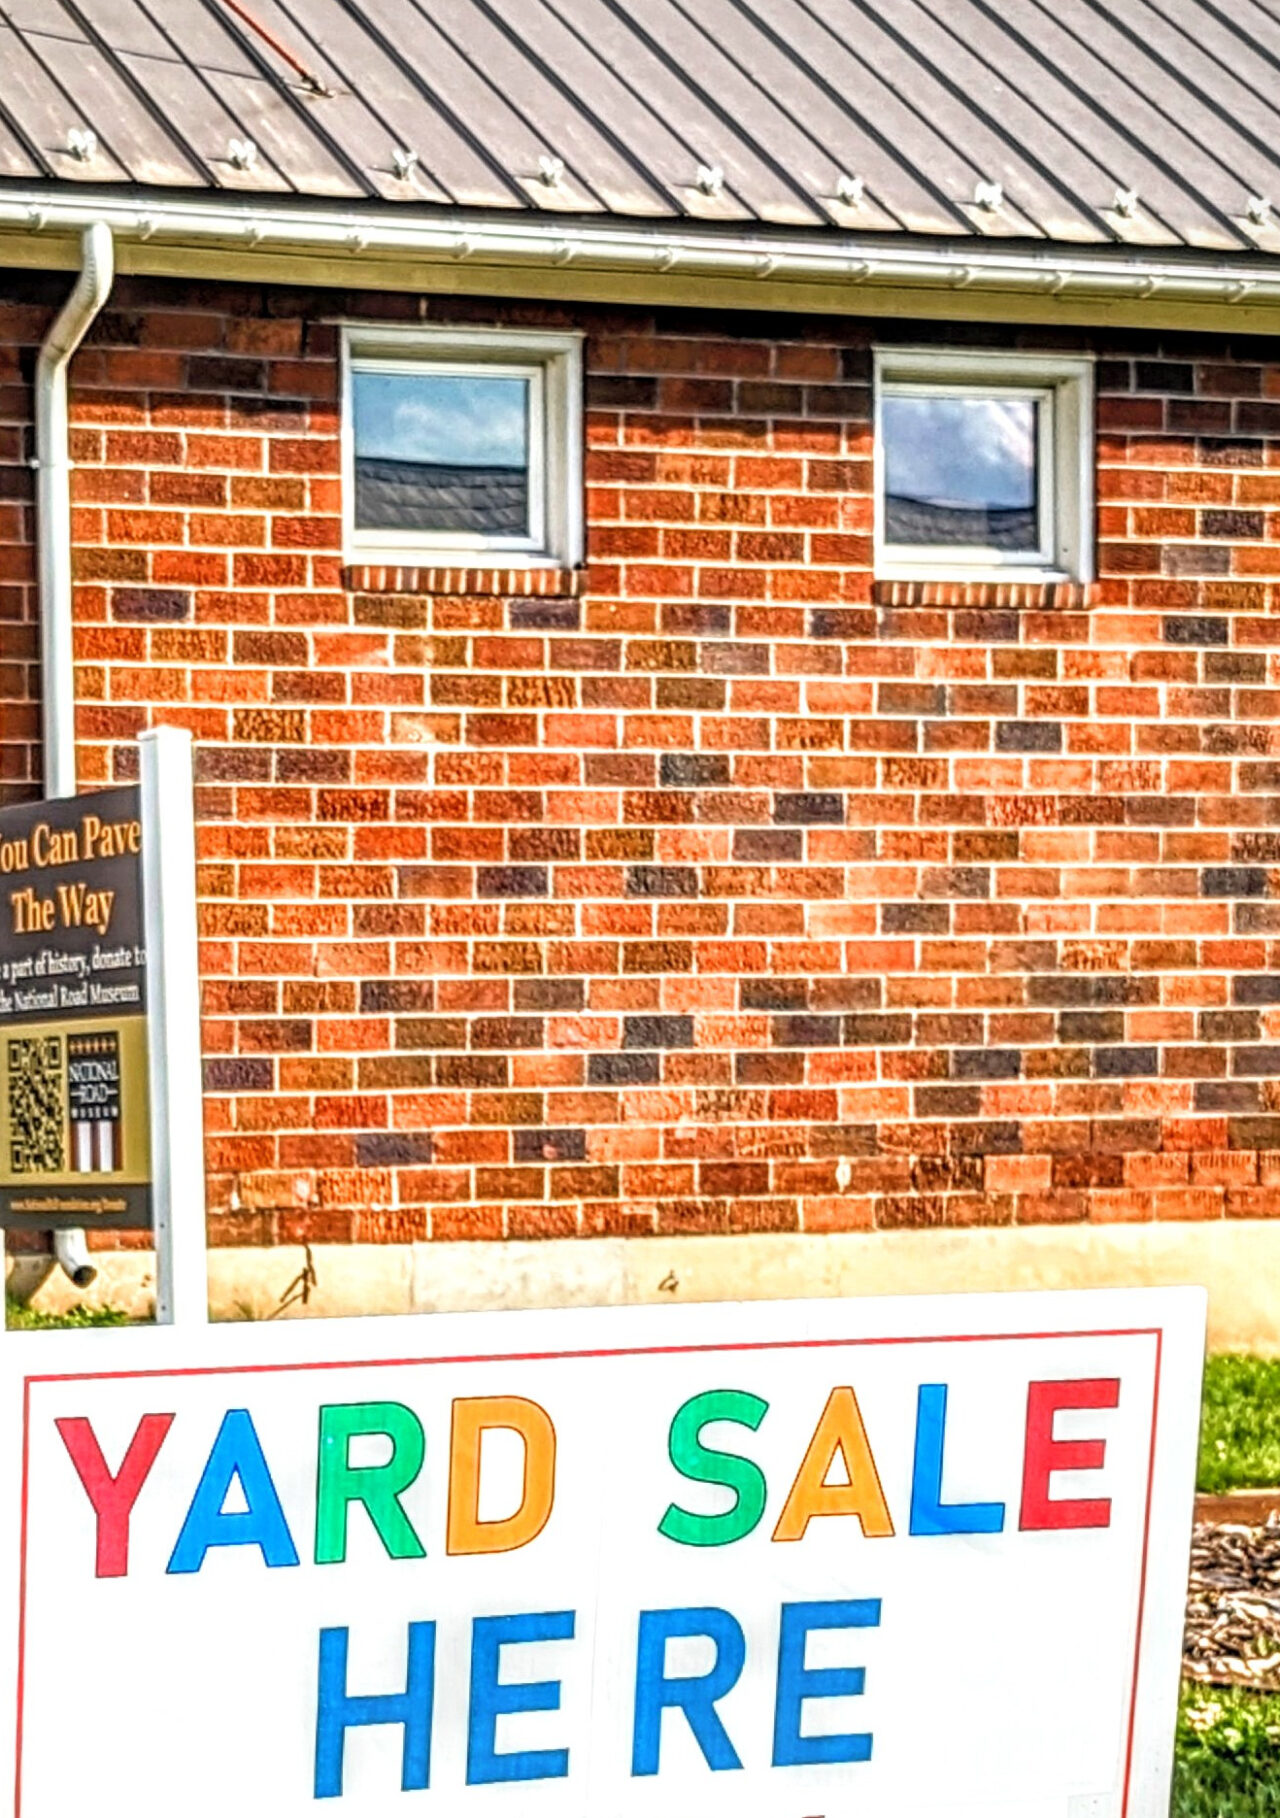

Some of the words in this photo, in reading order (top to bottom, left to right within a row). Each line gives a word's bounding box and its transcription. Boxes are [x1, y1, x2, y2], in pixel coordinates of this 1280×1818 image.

[33, 823, 80, 869] Can
[82, 815, 142, 861] Pave
[11, 887, 56, 934] The
[58, 883, 115, 936] Way
[3, 964, 10, 980] a
[10, 957, 34, 986] part
[35, 951, 48, 977] of
[48, 951, 91, 979] history,
[91, 945, 132, 971] donate
[134, 945, 147, 966] to
[14, 984, 58, 1011] National
[60, 981, 88, 1007] Road
[90, 983, 140, 1005] Museum
[55, 1395, 557, 1578] YARD
[658, 1378, 1120, 1547] SALE
[314, 1598, 881, 1799] HERE
